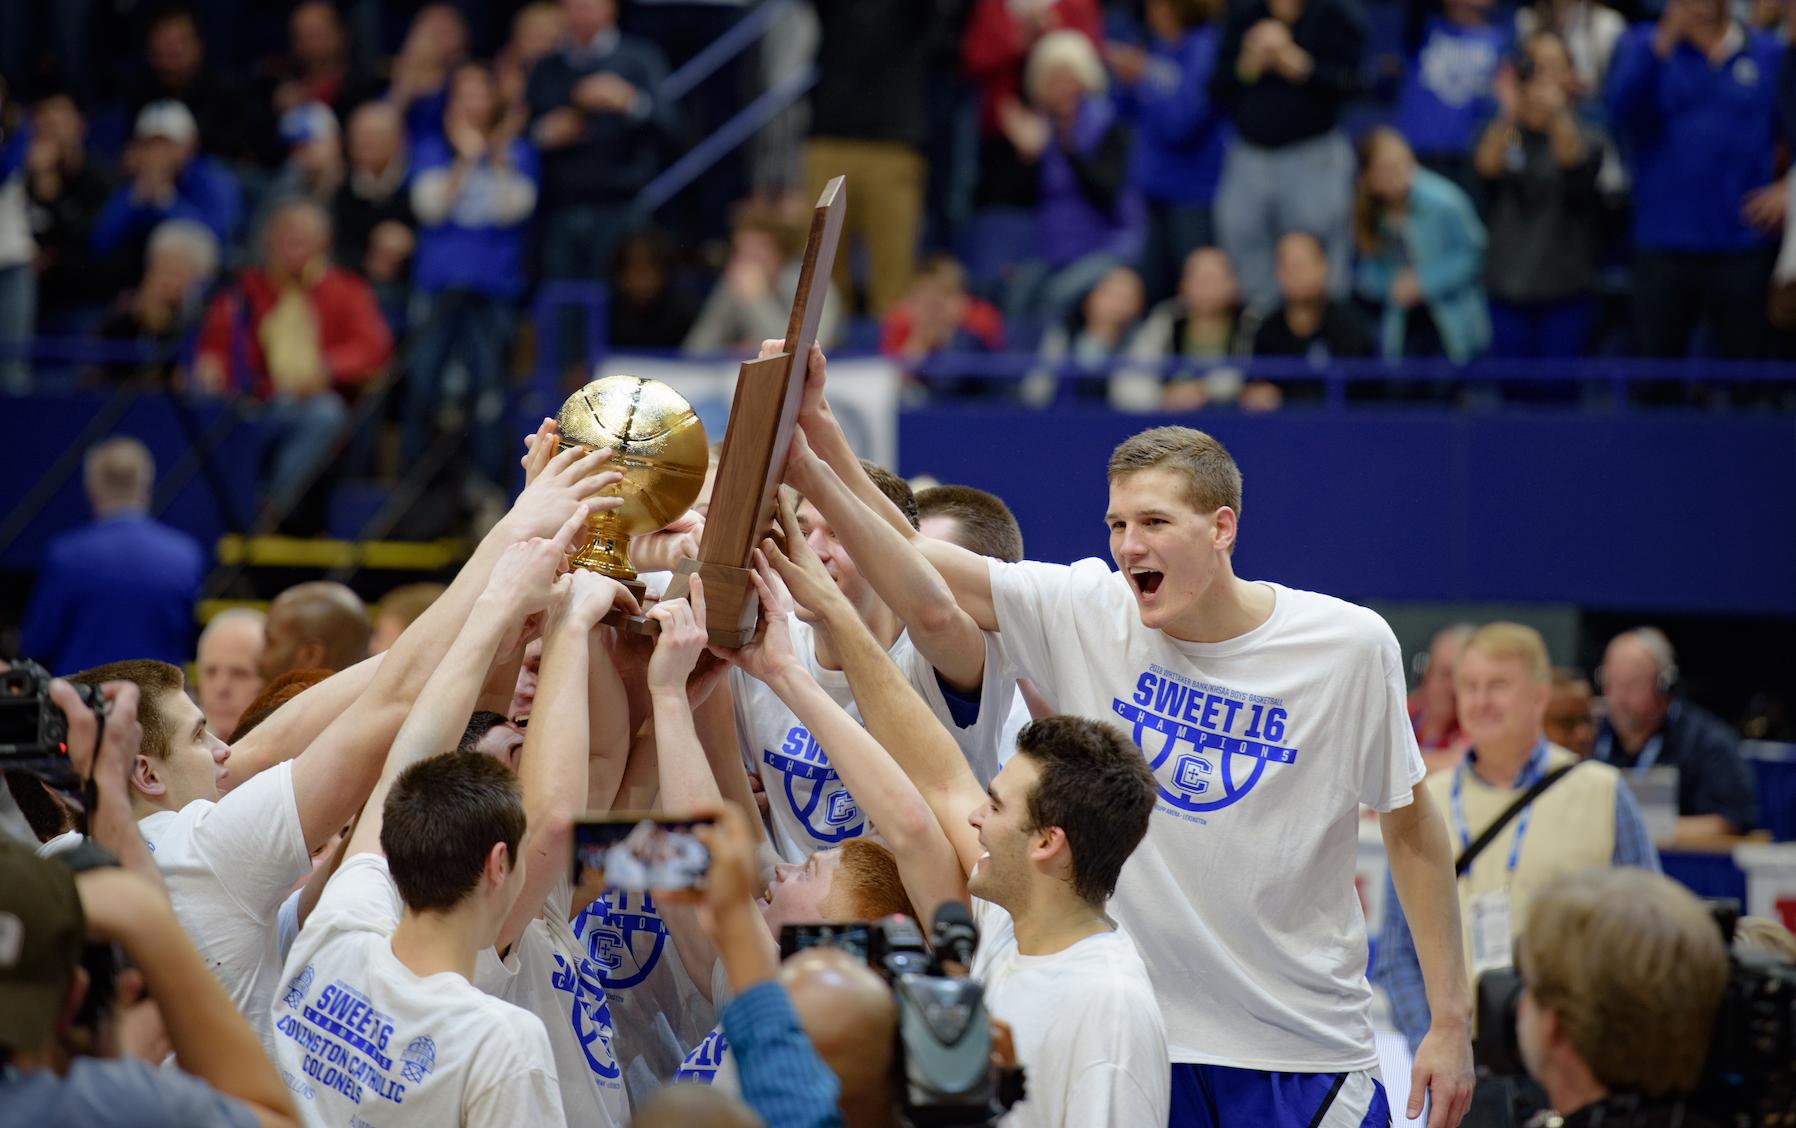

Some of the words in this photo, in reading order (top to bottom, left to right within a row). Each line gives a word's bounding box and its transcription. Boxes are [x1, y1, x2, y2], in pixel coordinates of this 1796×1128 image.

[1133, 671, 1244, 734] SWEET
[1244, 704, 1288, 743] 16
[1248, 693, 1284, 706] BASKETBALL
[1117, 703, 1290, 762] CHAMPIONS
[276, 1014, 350, 1068] COVINGTON
[302, 1053, 362, 1105] COLONELS
